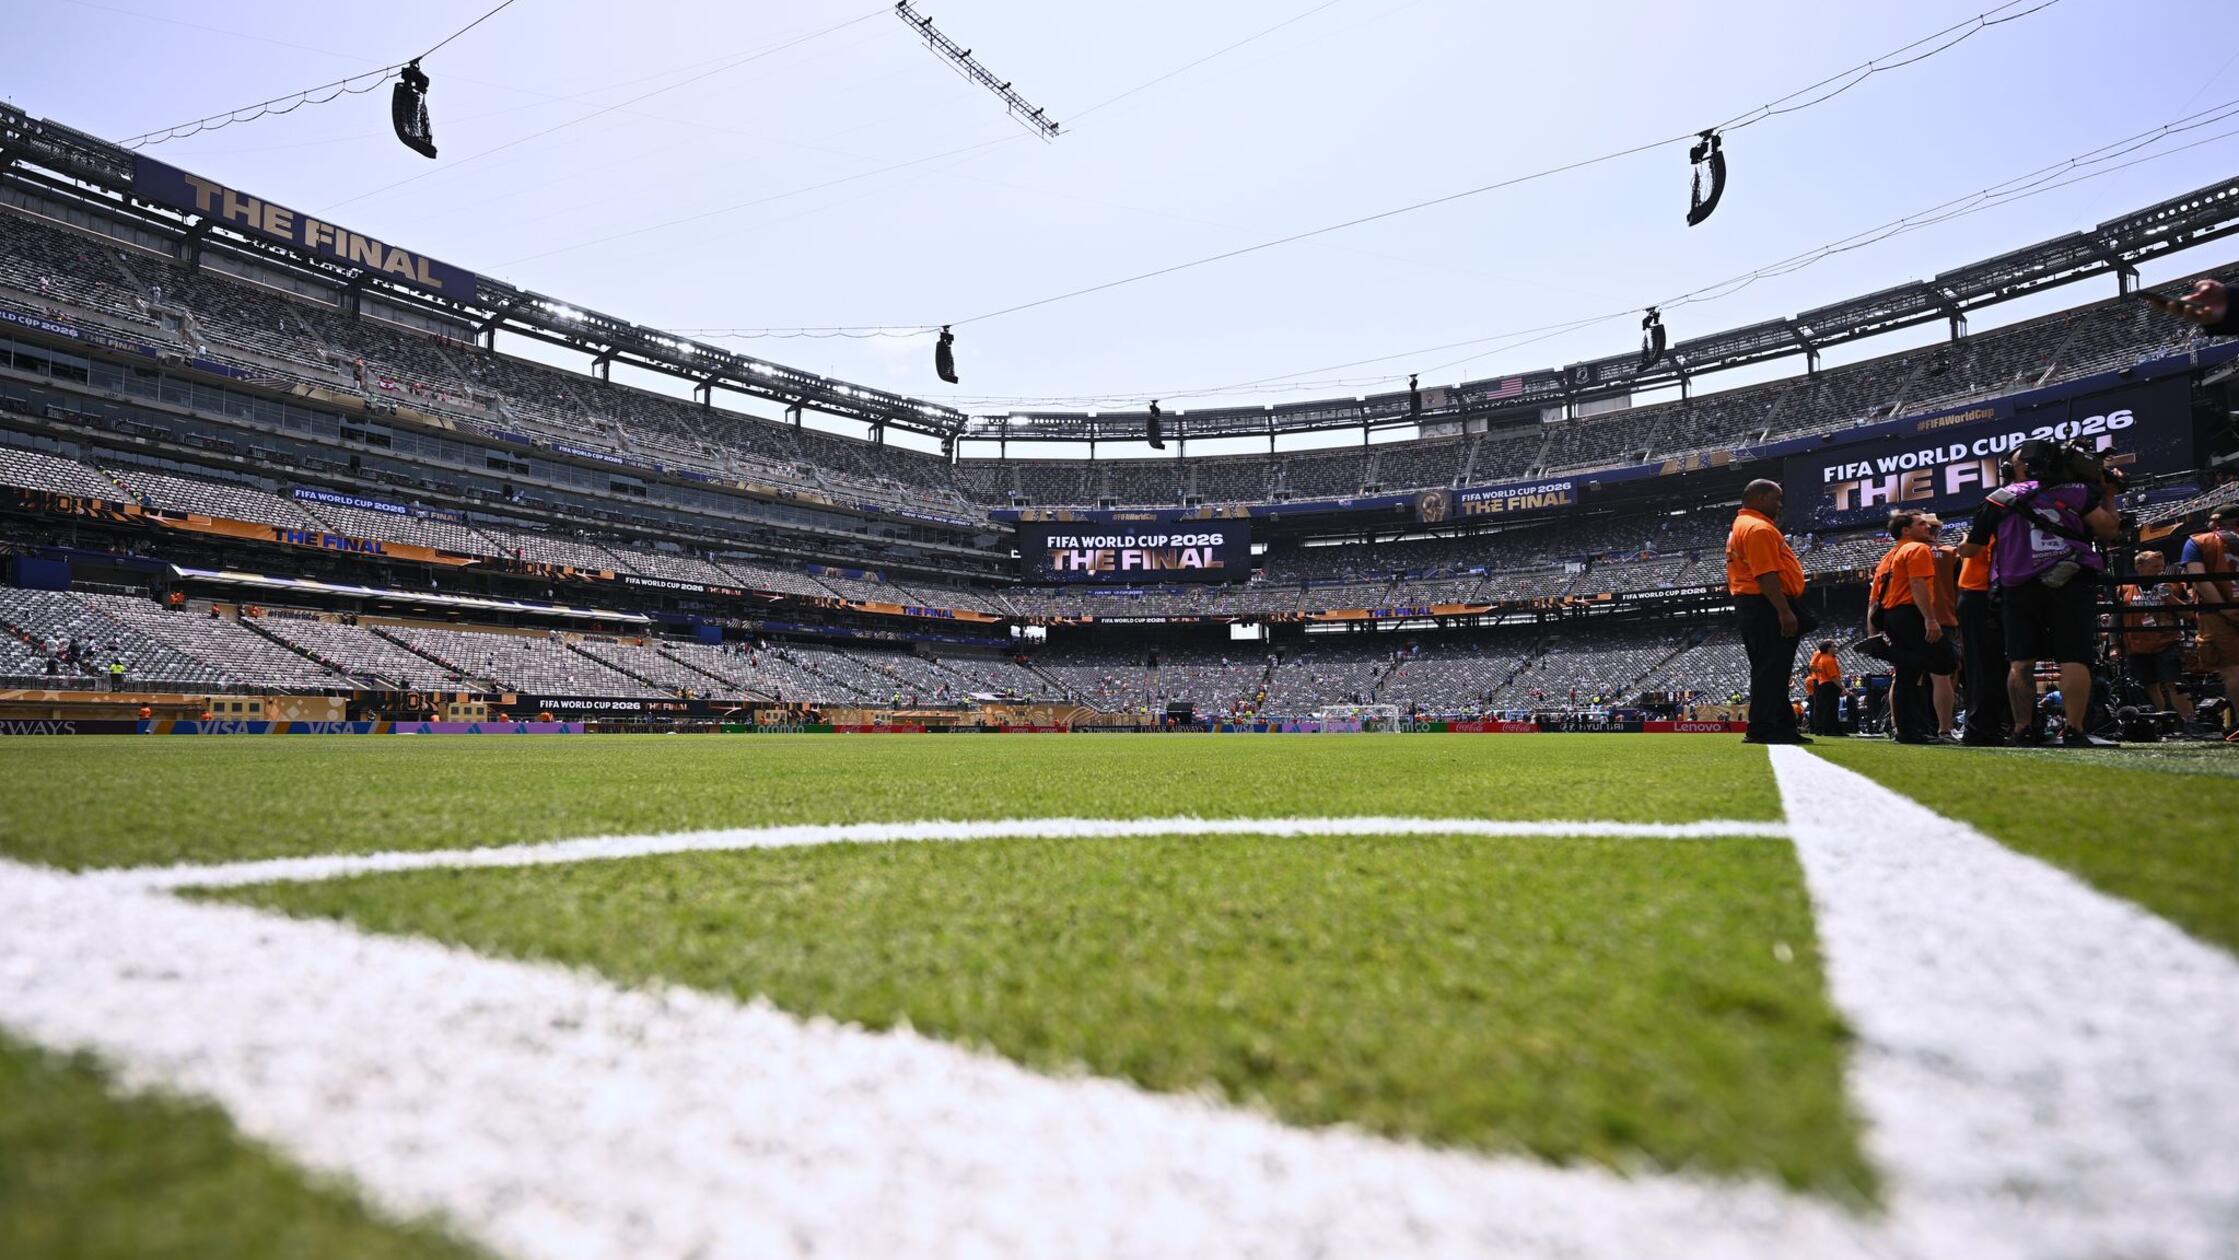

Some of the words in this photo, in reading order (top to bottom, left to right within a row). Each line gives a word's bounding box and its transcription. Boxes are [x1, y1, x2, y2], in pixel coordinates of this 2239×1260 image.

[185, 174, 293, 239] THE
[305, 218, 442, 288] FINAL
[18, 316, 40, 327] CUP
[41, 322, 79, 338] 2026
[1916, 407, 1995, 432] #FIFAWorldCup
[1824, 460, 1874, 482] FIFA
[1876, 445, 1967, 474] WORLD
[1972, 432, 2026, 456] CUP
[2030, 409, 2135, 442] 2026
[1824, 468, 1934, 511] THE
[1945, 434, 2137, 495] FIL
[295, 489, 317, 500] FIFA
[318, 494, 353, 505] WORLD
[354, 499, 373, 508] CUP
[374, 503, 406, 514] 2026
[1461, 494, 1481, 502] FIFA
[1482, 489, 1516, 500] WORLD
[1517, 487, 1537, 496] CUP
[1538, 482, 1572, 493] 2026
[1462, 499, 1504, 515] THE
[1508, 491, 1572, 511] FINAL
[272, 527, 319, 547] THE
[322, 533, 388, 555] FINAL
[1047, 536, 1080, 548] FIFA
[1081, 536, 1136, 548] WORLD
[1138, 535, 1168, 547] CUP
[1169, 533, 1224, 547] 2026
[1050, 549, 1116, 571] THE
[1121, 547, 1225, 571] FINAL
[625, 577, 640, 585] FIFA
[641, 579, 666, 588] WORLD
[681, 583, 704, 592] 2026
[1638, 591, 1664, 599] WORLD
[1680, 587, 1707, 595] 2026
[903, 605, 922, 616] THE
[923, 607, 955, 618] FINAL
[1366, 609, 1392, 618] THE
[1394, 606, 1434, 617] FINAL
[539, 700, 560, 709] FIFA
[560, 700, 593, 709] WORLD
[594, 701, 611, 710] CUP
[612, 702, 641, 710] 2026
[192, 721, 249, 735] VISA
[306, 722, 355, 735] VISA
[1674, 722, 1722, 732] Lenovo
